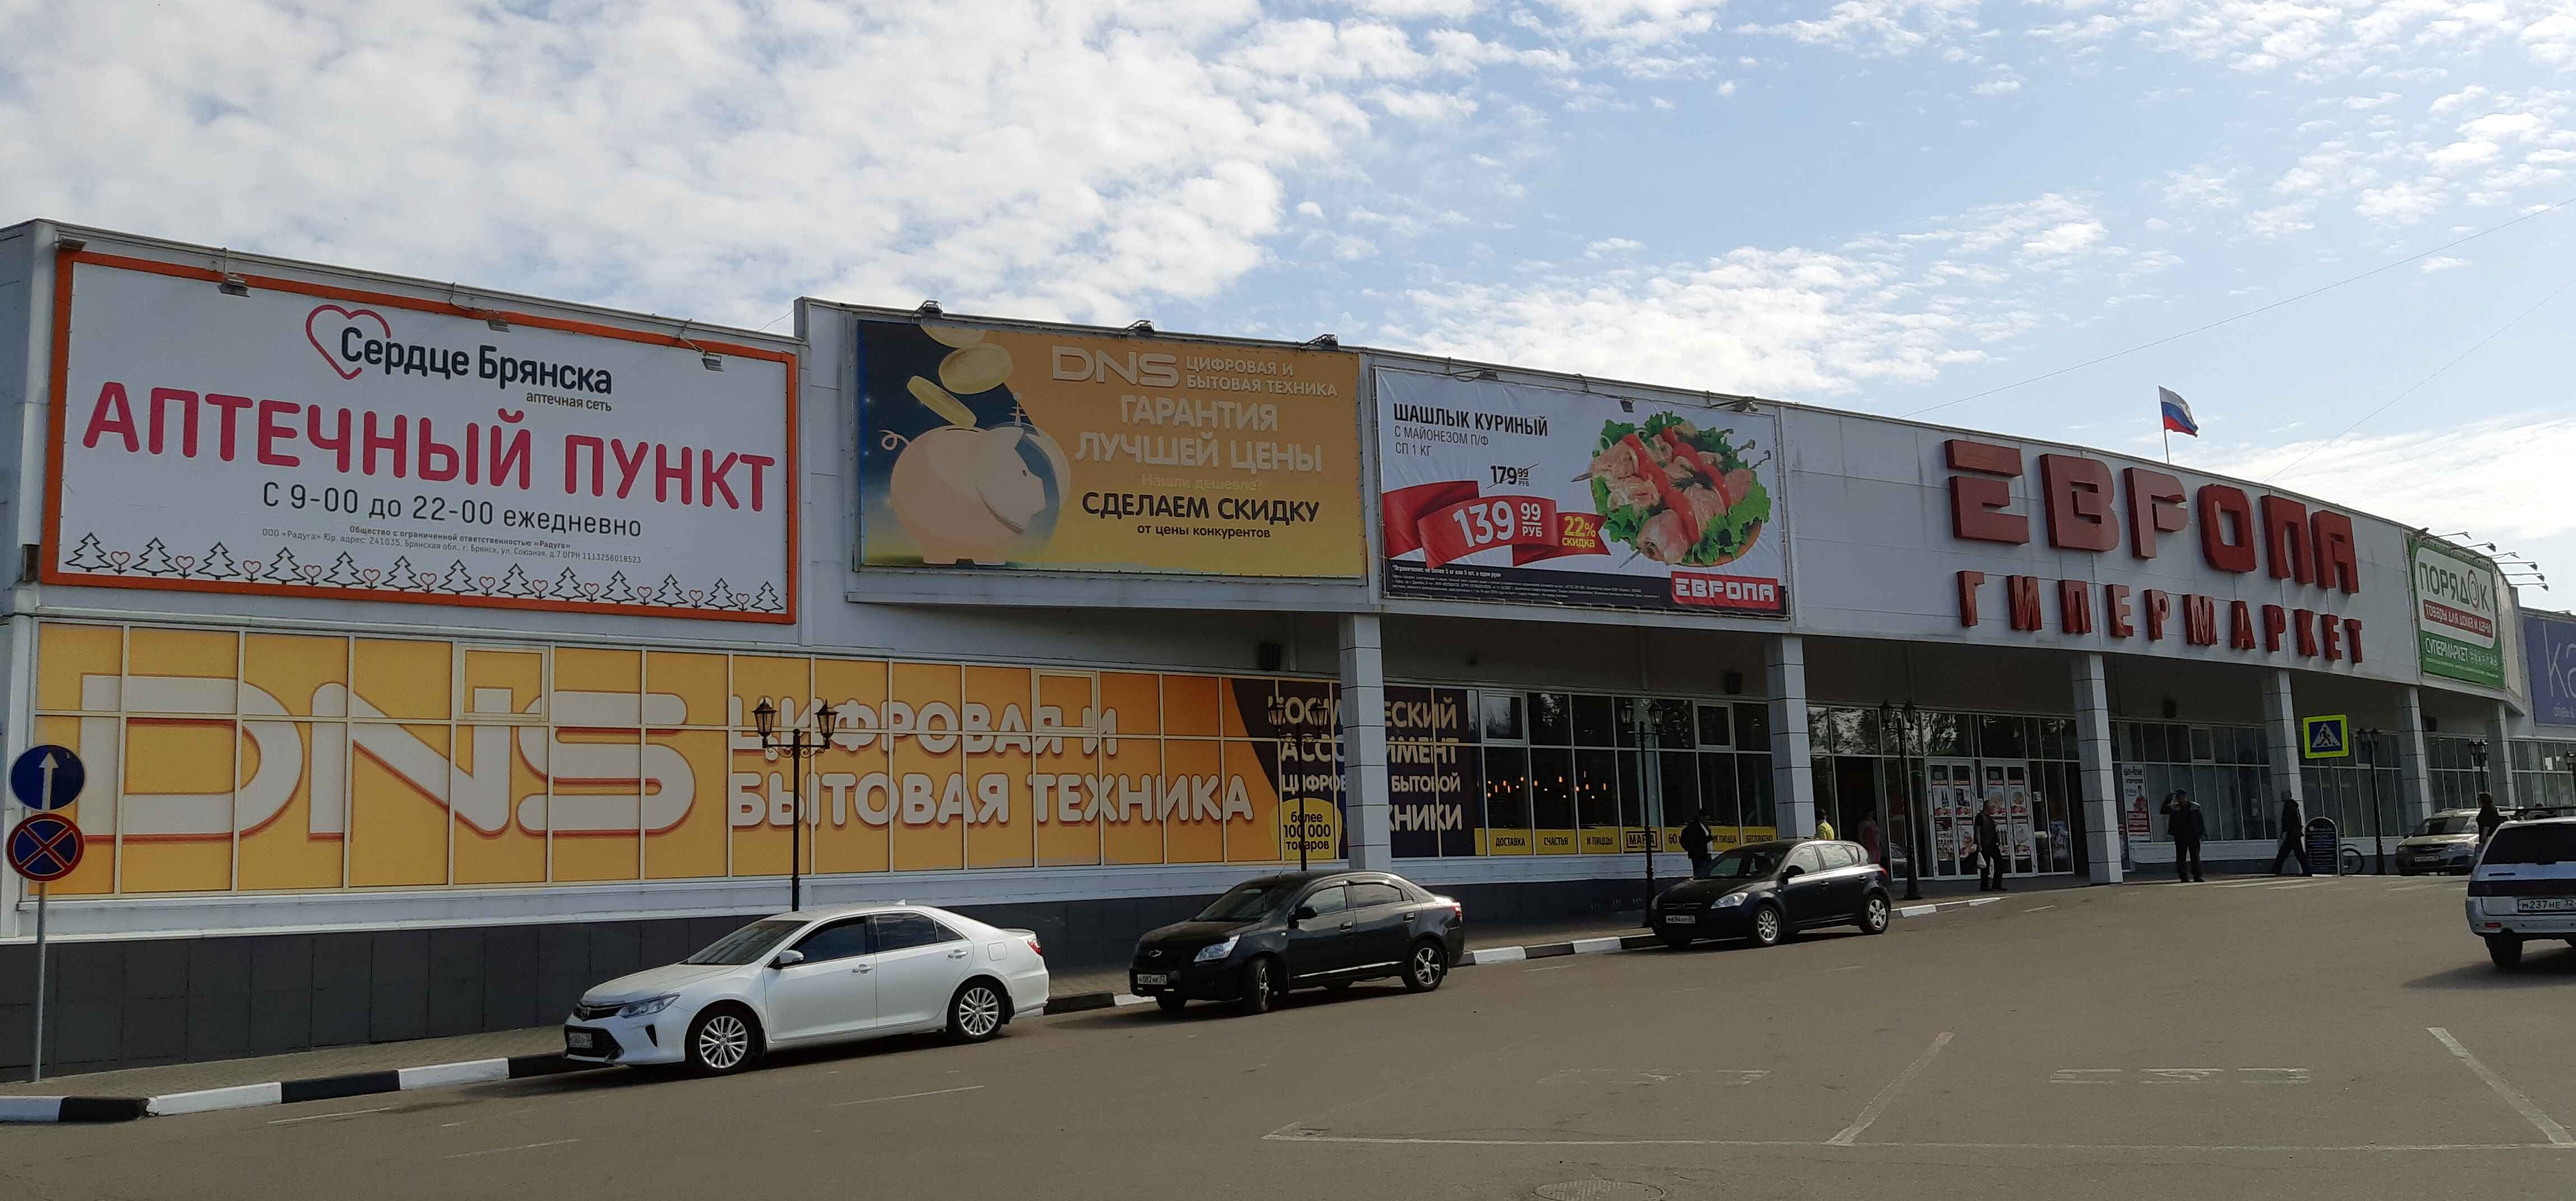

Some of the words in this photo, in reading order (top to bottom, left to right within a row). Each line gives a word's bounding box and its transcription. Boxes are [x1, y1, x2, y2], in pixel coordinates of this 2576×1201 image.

[341, 327, 470, 381] Сердце
[478, 345, 612, 394] Брянска
[1052, 345, 1178, 388] DNS
[1185, 356, 1277, 376] ЦИФРОВАЯ
[1281, 362, 1294, 377] И
[1186, 375, 1262, 393] БЫТОВАЯ
[1265, 379, 1339, 398] ТЕХНИКА
[526, 392, 583, 409] аптечная
[586, 398, 612, 412] сеть
[1121, 394, 1279, 432] ГАРАНТИЯ
[1394, 403, 1470, 429] ШАШЛЫК
[1474, 412, 1548, 436] КУРИНЫЙ
[82, 381, 531, 490] АПТЕЧНЫЙ
[565, 434, 776, 512] ПУНКТ
[1394, 426, 1401, 437] С
[1404, 426, 1468, 445] МАЙОНЕЗОМ
[1470, 434, 1489, 446] П/Ф
[1075, 431, 1219, 467] ЛУЧШЕЙ
[1230, 440, 1322, 474] ЦЕНЫ
[1395, 442, 1409, 454] СП
[1412, 444, 1417, 455] 1
[1421, 445, 1432, 457] КГ
[1141, 473, 1191, 488] Нашли
[1195, 478, 1263, 491] дешевле?
[1490, 465, 1517, 485] 179
[1517, 468, 1529, 478] 99
[263, 481, 279, 507] С
[290, 484, 359, 514] 9-00
[368, 497, 402, 520] до
[412, 495, 493, 525] 22-00
[503, 506, 642, 537] ежедневно
[1082, 492, 1210, 519] СДЕЛАЕМ
[1218, 497, 1320, 526] СКИДКУ
[1944, 439, 2359, 594] ЕВРОПА
[1137, 525, 1152, 534] от
[1155, 526, 1189, 538] цены
[1193, 528, 1271, 539] конкурентов
[1452, 501, 1515, 548] 139
[1520, 502, 1542, 520] 99
[1522, 525, 1542, 537] РУБ
[1563, 515, 1596, 537] 22%
[262, 528, 279, 537] ООО
[282, 530, 321, 541] «Радуга»
[341, 536, 366, 544] адрес:
[405, 541, 441, 550] Брянская
[471, 545, 499, 555] Брянск,
[514, 548, 547, 558] Союзная,
[563, 551, 581, 560] ОГРН
[350, 525, 391, 536] Общество
[400, 530, 457, 541] ограниченной
[460, 536, 531, 547] ответственностью
[534, 541, 570, 550] «Радуга»
[1562, 537, 1595, 548] скидка
[1674, 575, 1775, 602] ЕВРОПА
[2419, 561, 2490, 612] ПОРЯДОК
[1956, 570, 2363, 663] ГИПЕРМАРКЕТ
[2425, 604, 2447, 622] ТОВАРЫ
[2448, 611, 2458, 624] ДЛЯ
[2425, 637, 2468, 662] СУПЕРМАРКЕТ
[731, 695, 1062, 761] ЦИФРОВАЯ
[1082, 707, 1117, 755] И
[77, 674, 696, 842] DNS
[1391, 772, 1461, 793] БЫТОВОЙ
[731, 772, 1009, 827] БЫТОВАЯ
[1026, 774, 1254, 822] ТЕХНИКА
[1308, 824, 1331, 837] 000
[1495, 836, 1526, 846] ДОСТАВКА
[1543, 837, 1568, 846] СЧАСТЬЯ
[1586, 836, 1591, 845] И
[1591, 836, 1614, 845] ПИЦЦЫ
[1668, 834, 1677, 844] 60
[1719, 835, 1737, 843] ПИЦЦА
[2522, 900, 2560, 910] М237НЕ
